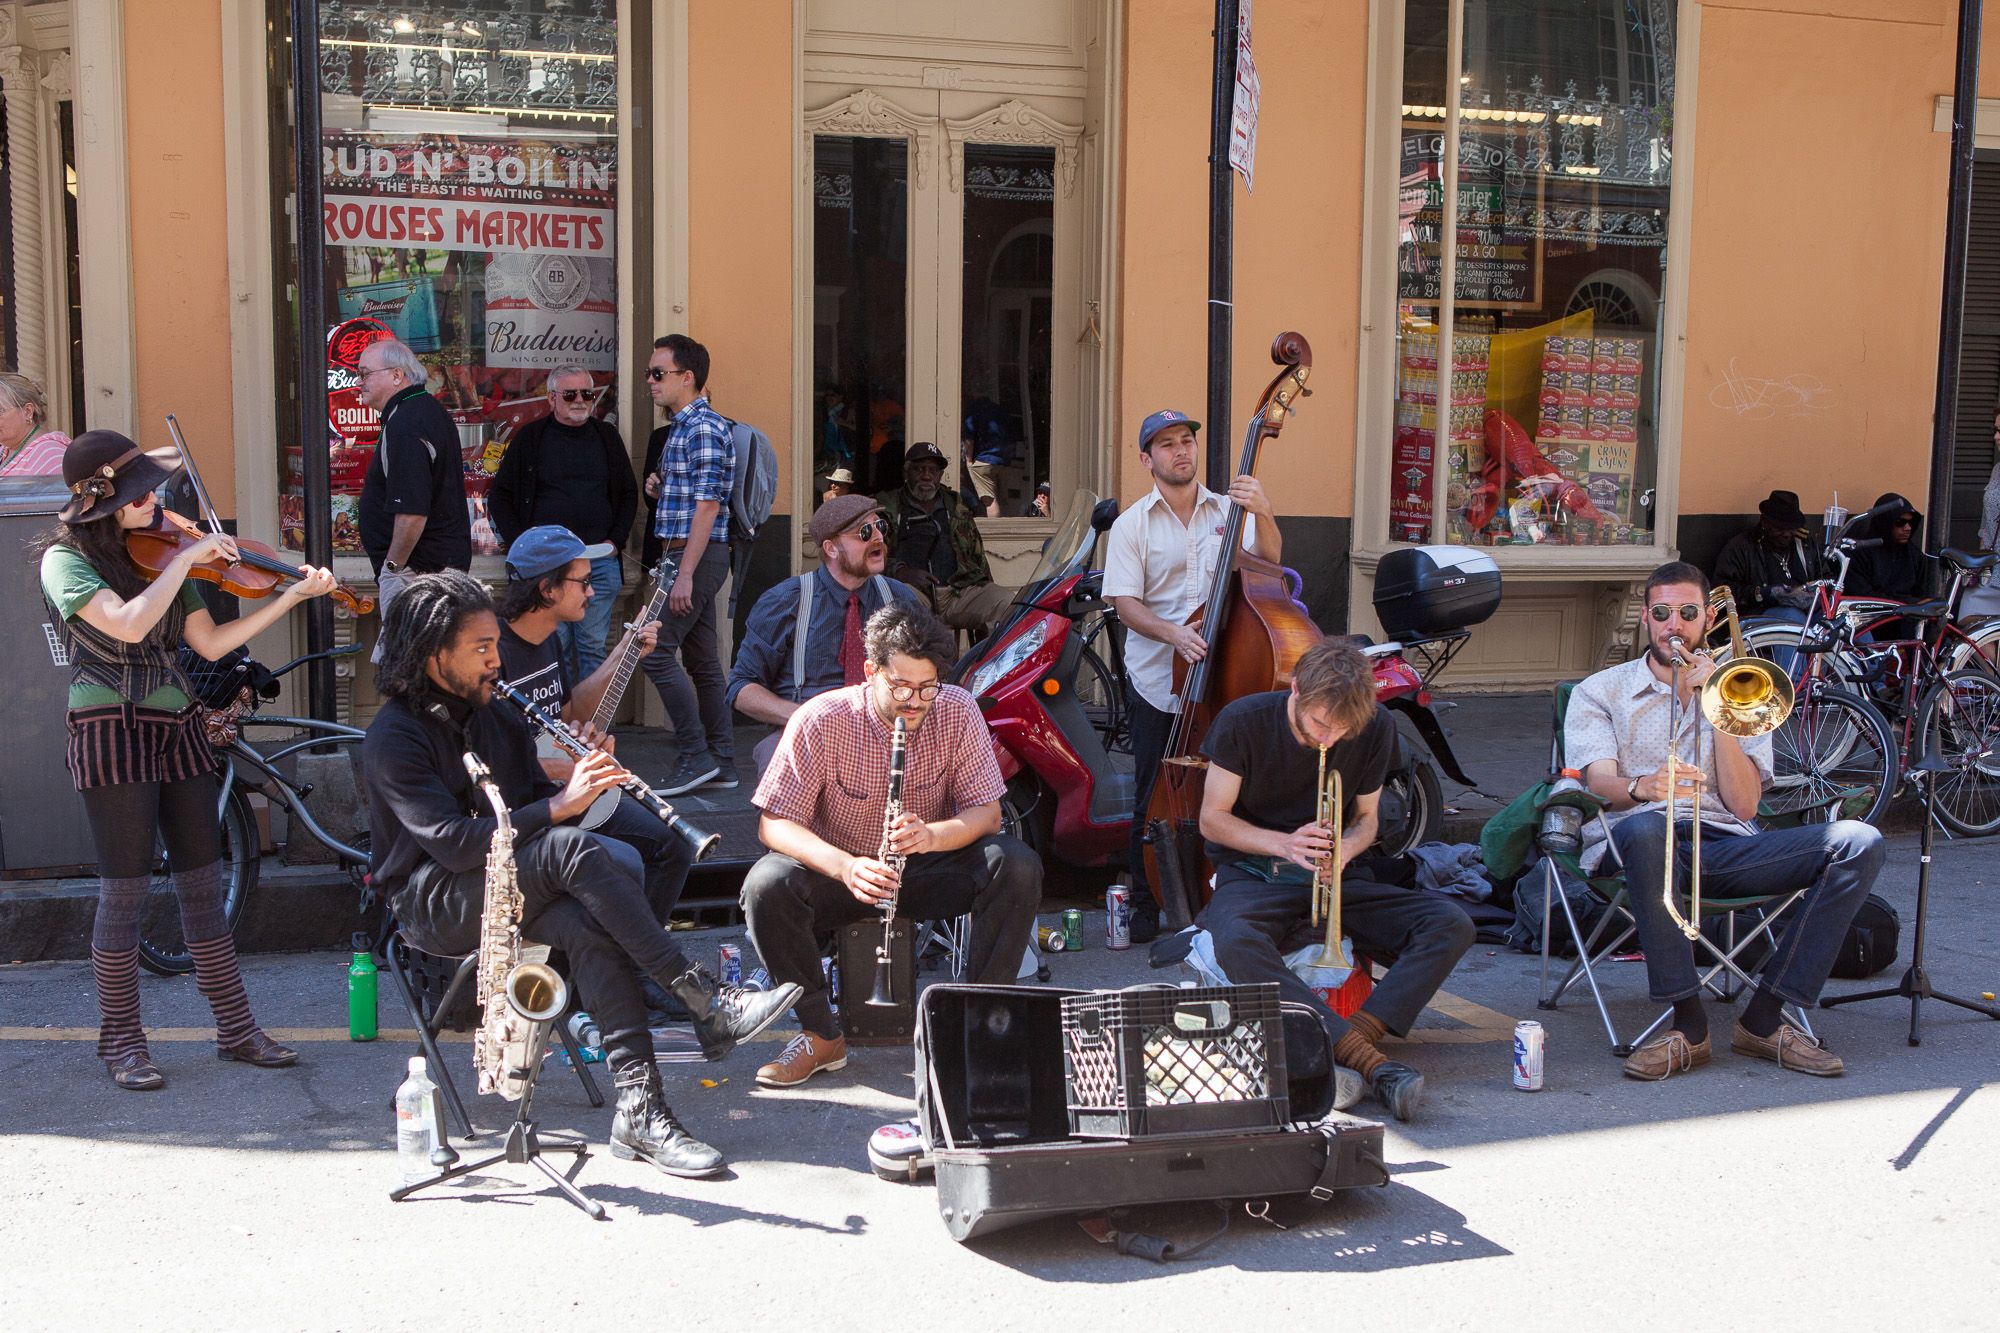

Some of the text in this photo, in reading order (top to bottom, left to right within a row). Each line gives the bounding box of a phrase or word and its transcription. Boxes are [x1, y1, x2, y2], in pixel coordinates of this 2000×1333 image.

[1404, 136, 1504, 166] ELCME TO
[468, 154, 609, 191] BOILIN
[377, 181, 544, 200] THE FEAST IS WAITING
[1400, 184, 1492, 208] rench arter
[325, 202, 604, 250] ROUSES MARKETS
[1456, 245, 1469, 257] AB
[1482, 246, 1496, 258] GO
[1422, 259, 1442, 267] FRES
[1493, 277, 1513, 285] SUSHI
[1424, 283, 1440, 297] Bo
[363, 301, 405, 312] Budweiser
[488, 320, 616, 353] Budweise
[511, 355, 539, 363] KING
[566, 357, 601, 365] BEERS
[330, 460, 360, 468] udweiser
[1591, 498, 1614, 506] AMBALAYA
[1409, 511, 1432, 520] Collectio
[533, 679, 559, 702] Roch
